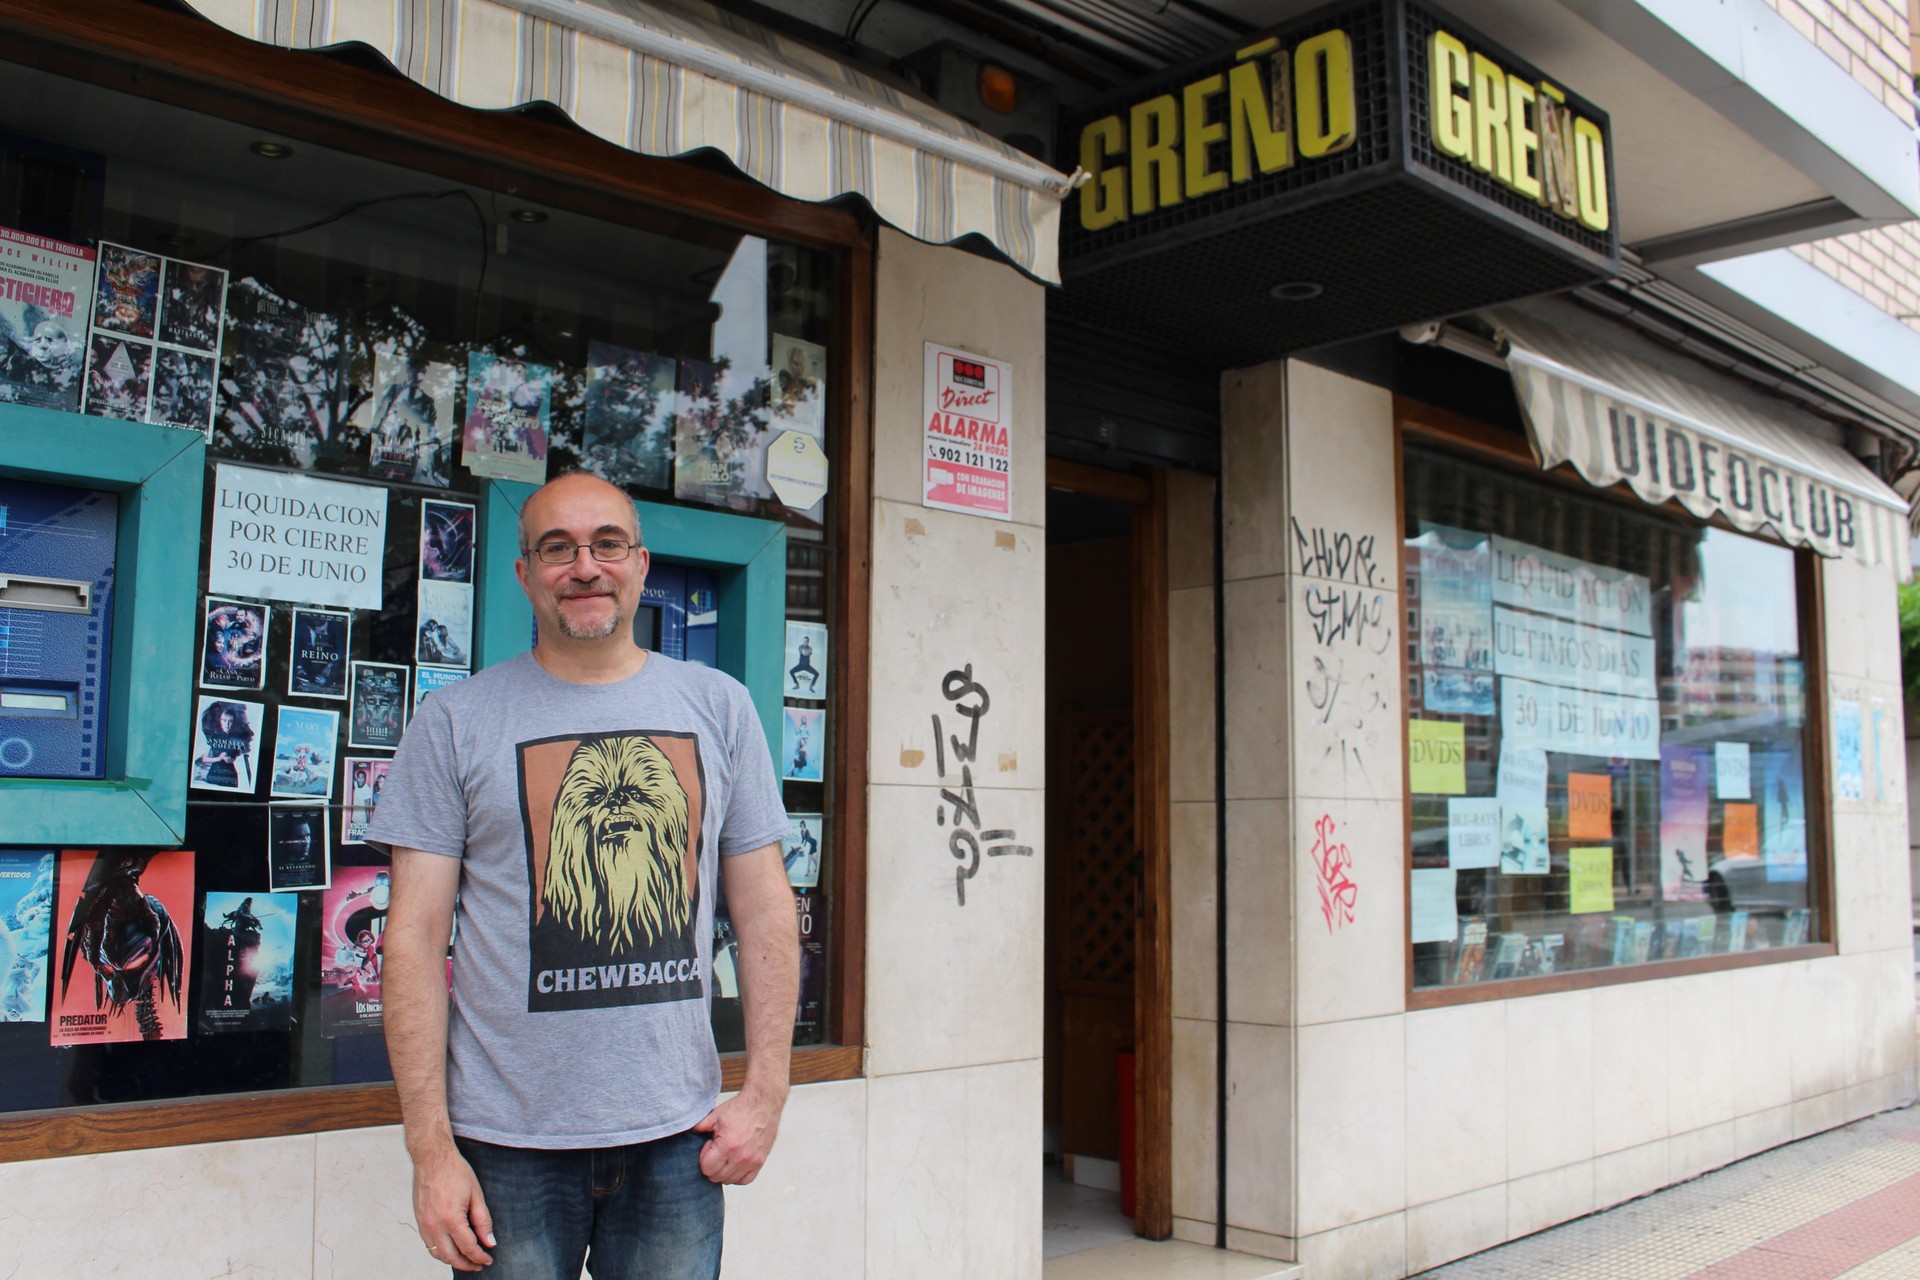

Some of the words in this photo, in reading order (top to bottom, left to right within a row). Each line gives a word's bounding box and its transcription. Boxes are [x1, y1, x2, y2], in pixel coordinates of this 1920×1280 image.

[46, 240, 54, 250] DE
[55, 243, 84, 257] TAQUILLA
[31, 253, 78, 272] WILLIS
[941, 386, 996, 409] Direct
[928, 412, 1008, 447] ALARMA
[939, 447, 961, 463] 902
[965, 452, 984, 468] 121
[990, 457, 1009, 473] 122
[973, 442, 983, 452] 24
[984, 444, 1009, 458] HORAS
[701, 471, 730, 482] SOLO
[702, 461, 728, 472] HAN
[956, 471, 970, 484] CON
[956, 483, 967, 495] DE
[967, 485, 1006, 501] IMAGENES
[220, 488, 381, 528] LIQUIDACION
[229, 519, 278, 545] POR
[284, 527, 369, 556] CIERRE
[227, 550, 253, 571] 30
[260, 553, 292, 576] DE
[297, 558, 367, 584] JUNIO
[301, 650, 339, 661] REINO
[1495, 621, 1593, 670] ULTIMOS
[1596, 644, 1641, 678] DIAS
[421, 671, 432, 679] EL
[433, 672, 463, 681] MUNDO
[295, 720, 320, 731] MARY
[1515, 693, 1538, 727] 30
[1558, 701, 1585, 735] DE
[1592, 706, 1650, 741] JUNIO
[1412, 738, 1462, 765] DVDS
[1571, 789, 1609, 815] DVDS
[223, 933, 236, 1007] ALPHA
[536, 958, 701, 994] CHEWBACCA
[355, 1001, 366, 1013] LOS
[59, 1014, 108, 1026] PREDATOR
